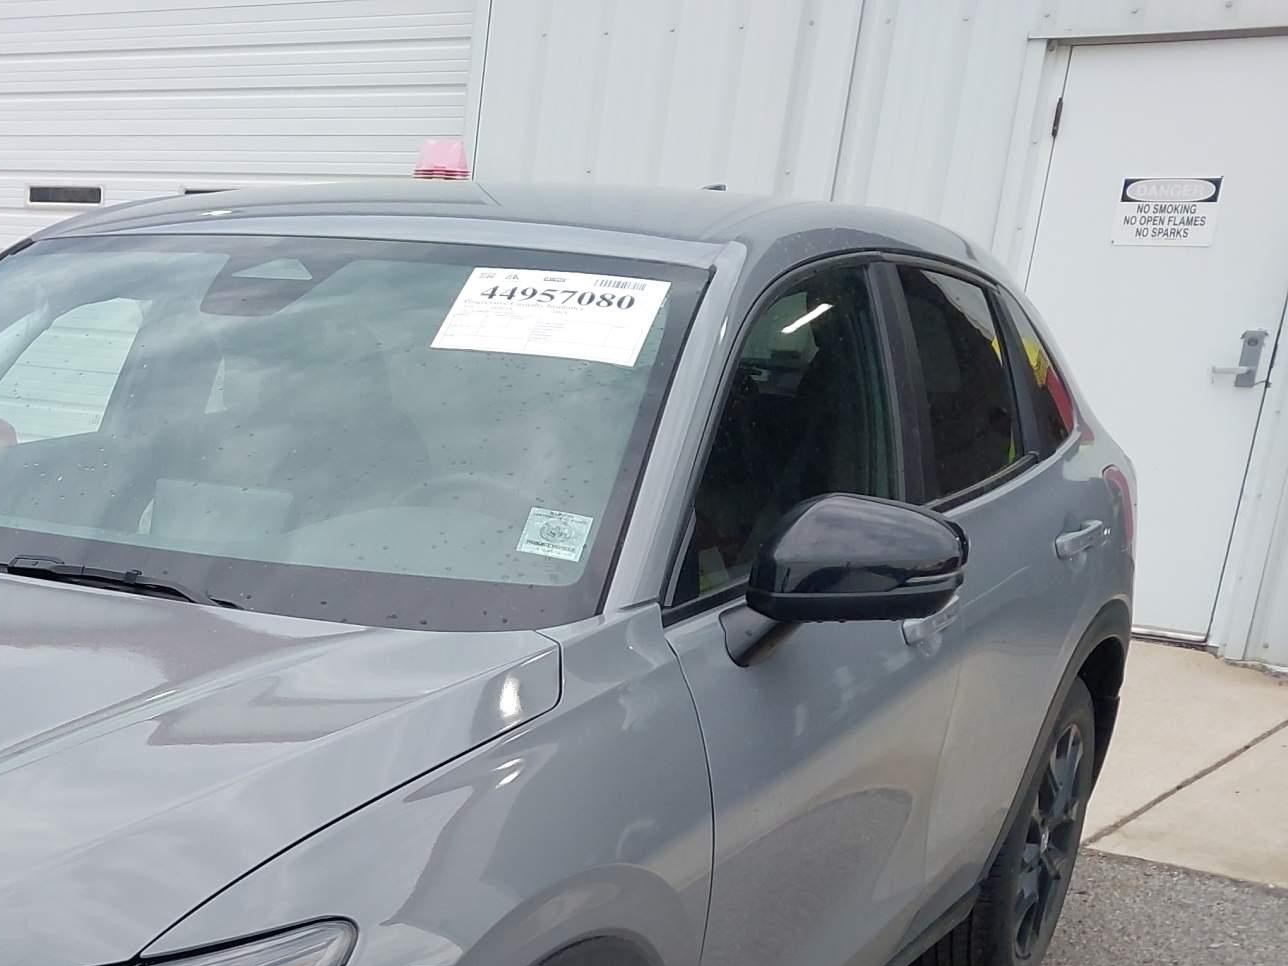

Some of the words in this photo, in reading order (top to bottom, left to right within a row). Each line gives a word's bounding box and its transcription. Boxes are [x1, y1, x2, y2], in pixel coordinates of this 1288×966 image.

[1136, 183, 1205, 197] DANGER
[1136, 203, 1151, 214] NO
[1152, 204, 1197, 214] SMOKING
[1123, 215, 1137, 225] NO
[1139, 216, 1166, 226] OPEN
[1167, 216, 1206, 226] FLAMES
[1135, 227, 1149, 237] NO
[1151, 228, 1189, 238] SPARKS
[480, 284, 636, 310] 44957080
